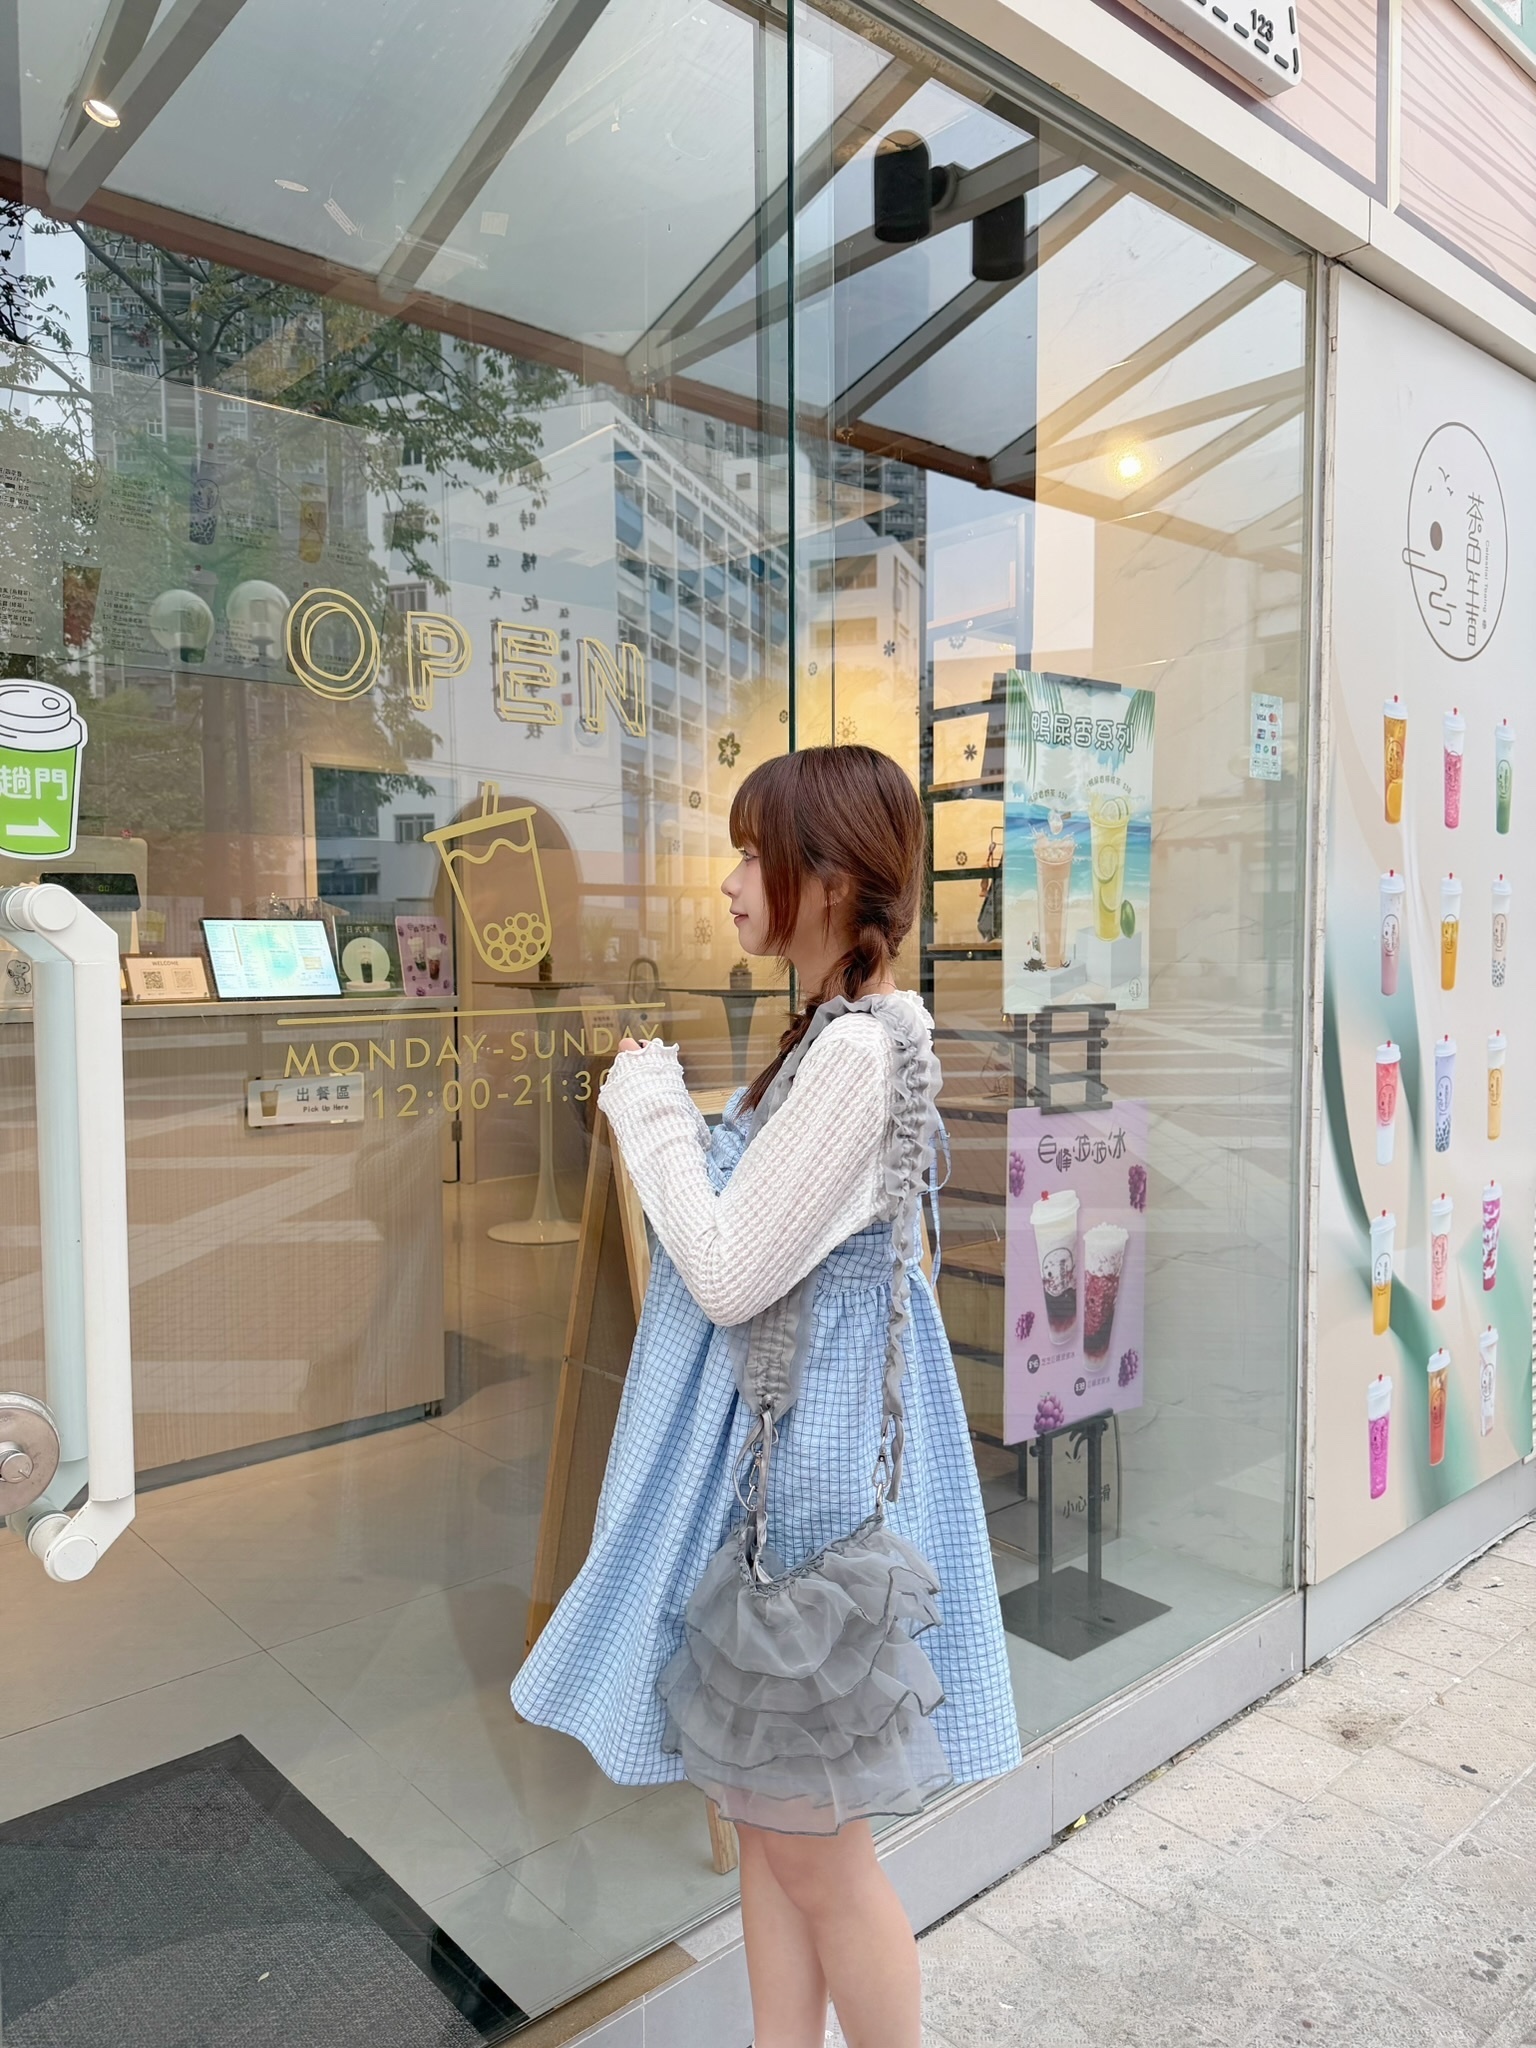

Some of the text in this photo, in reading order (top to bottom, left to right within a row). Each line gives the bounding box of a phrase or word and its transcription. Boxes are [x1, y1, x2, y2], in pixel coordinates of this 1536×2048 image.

[1250, 9, 1274, 42] 123
[286, 588, 646, 737] OPEN
[1031, 711, 1135, 754] 鴨屎香系列
[296, 1084, 351, 1102] 出餐區
[303, 1105, 319, 1113] Pick
[321, 1105, 331, 1113] Up
[1063, 1483, 1111, 1519] 小心滑
